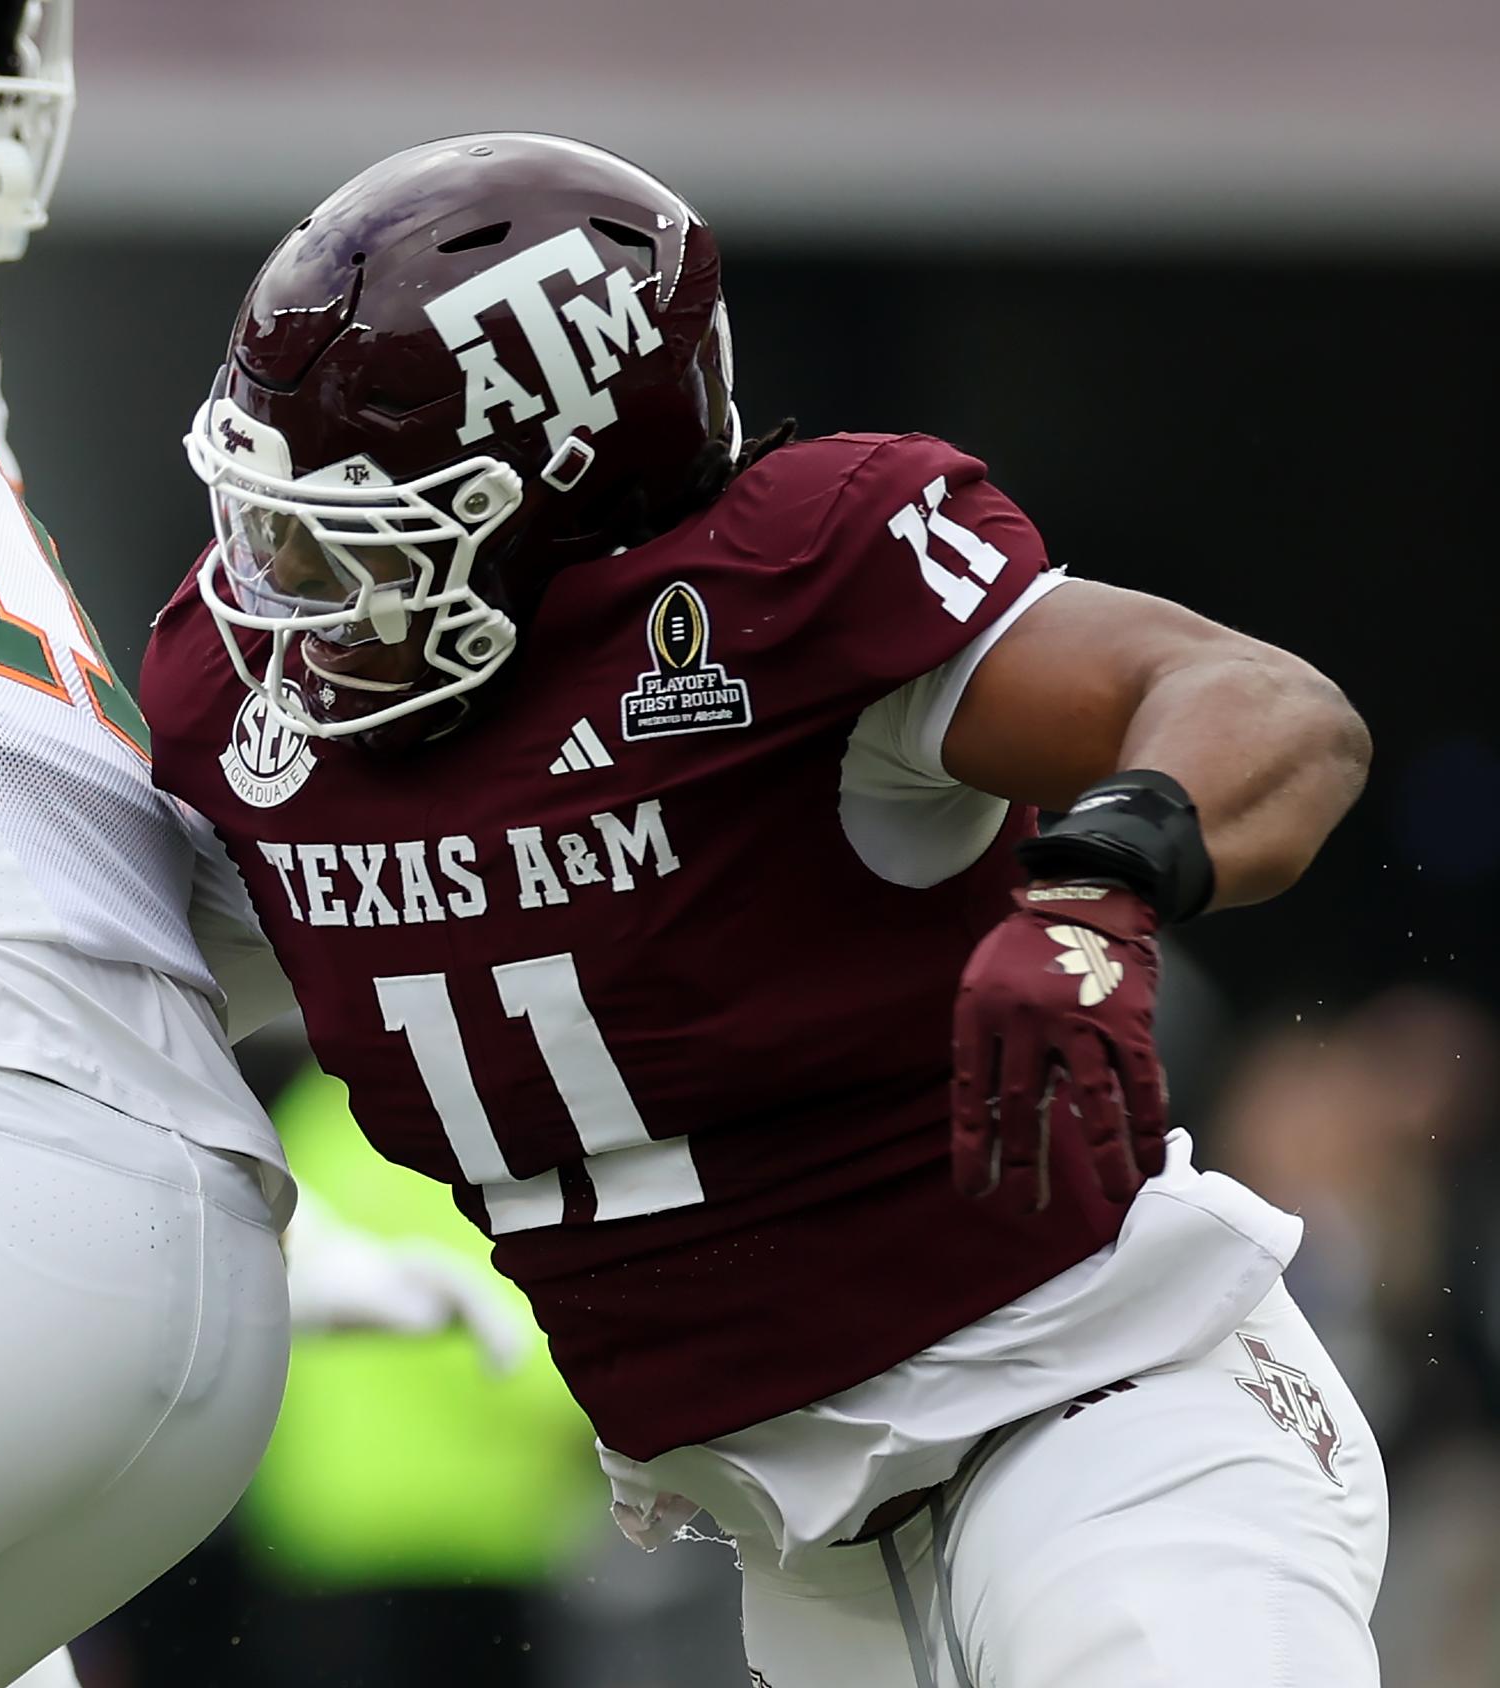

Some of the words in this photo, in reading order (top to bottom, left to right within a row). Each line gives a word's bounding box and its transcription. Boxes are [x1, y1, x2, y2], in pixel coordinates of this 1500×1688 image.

[888, 475, 1008, 623] 11
[628, 695, 677, 715] FIRST
[680, 689, 740, 708] ROUND
[645, 673, 718, 695] PLAYOFF
[231, 767, 301, 803] GRADUATE
[257, 835, 488, 927] TEXAS
[506, 799, 681, 909] A&M
[373, 952, 705, 1235] 11
